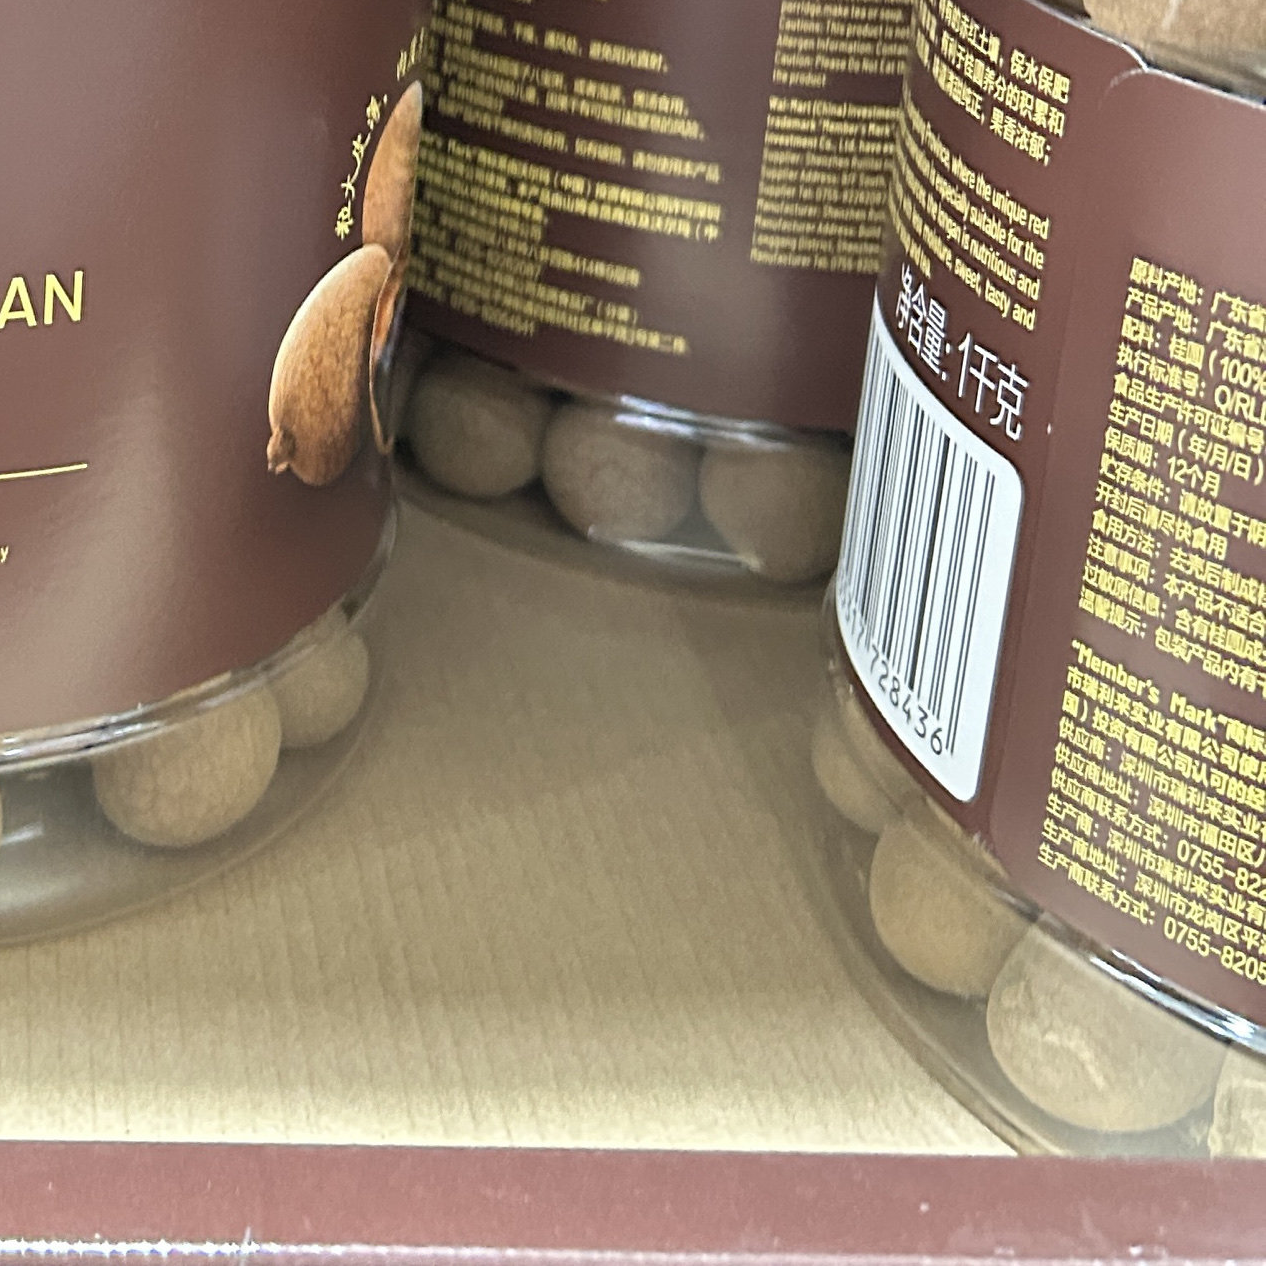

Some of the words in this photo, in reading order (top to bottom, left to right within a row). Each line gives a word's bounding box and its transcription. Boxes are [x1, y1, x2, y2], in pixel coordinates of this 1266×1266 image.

[970, 205, 1006, 246] suitable
[1006, 228, 1024, 257] for
[1024, 240, 1044, 270] the
[976, 172, 992, 202] the
[992, 189, 1027, 225] unique
[1028, 214, 1050, 240] red
[969, 238, 1017, 286] nutritious
[1016, 273, 1041, 301] and
[1129, 256, 1266, 332] 原料产地：广东省
[984, 277, 1011, 318] tasty
[1012, 303, 1036, 331] and
[870, 644, 943, 756] 728436
